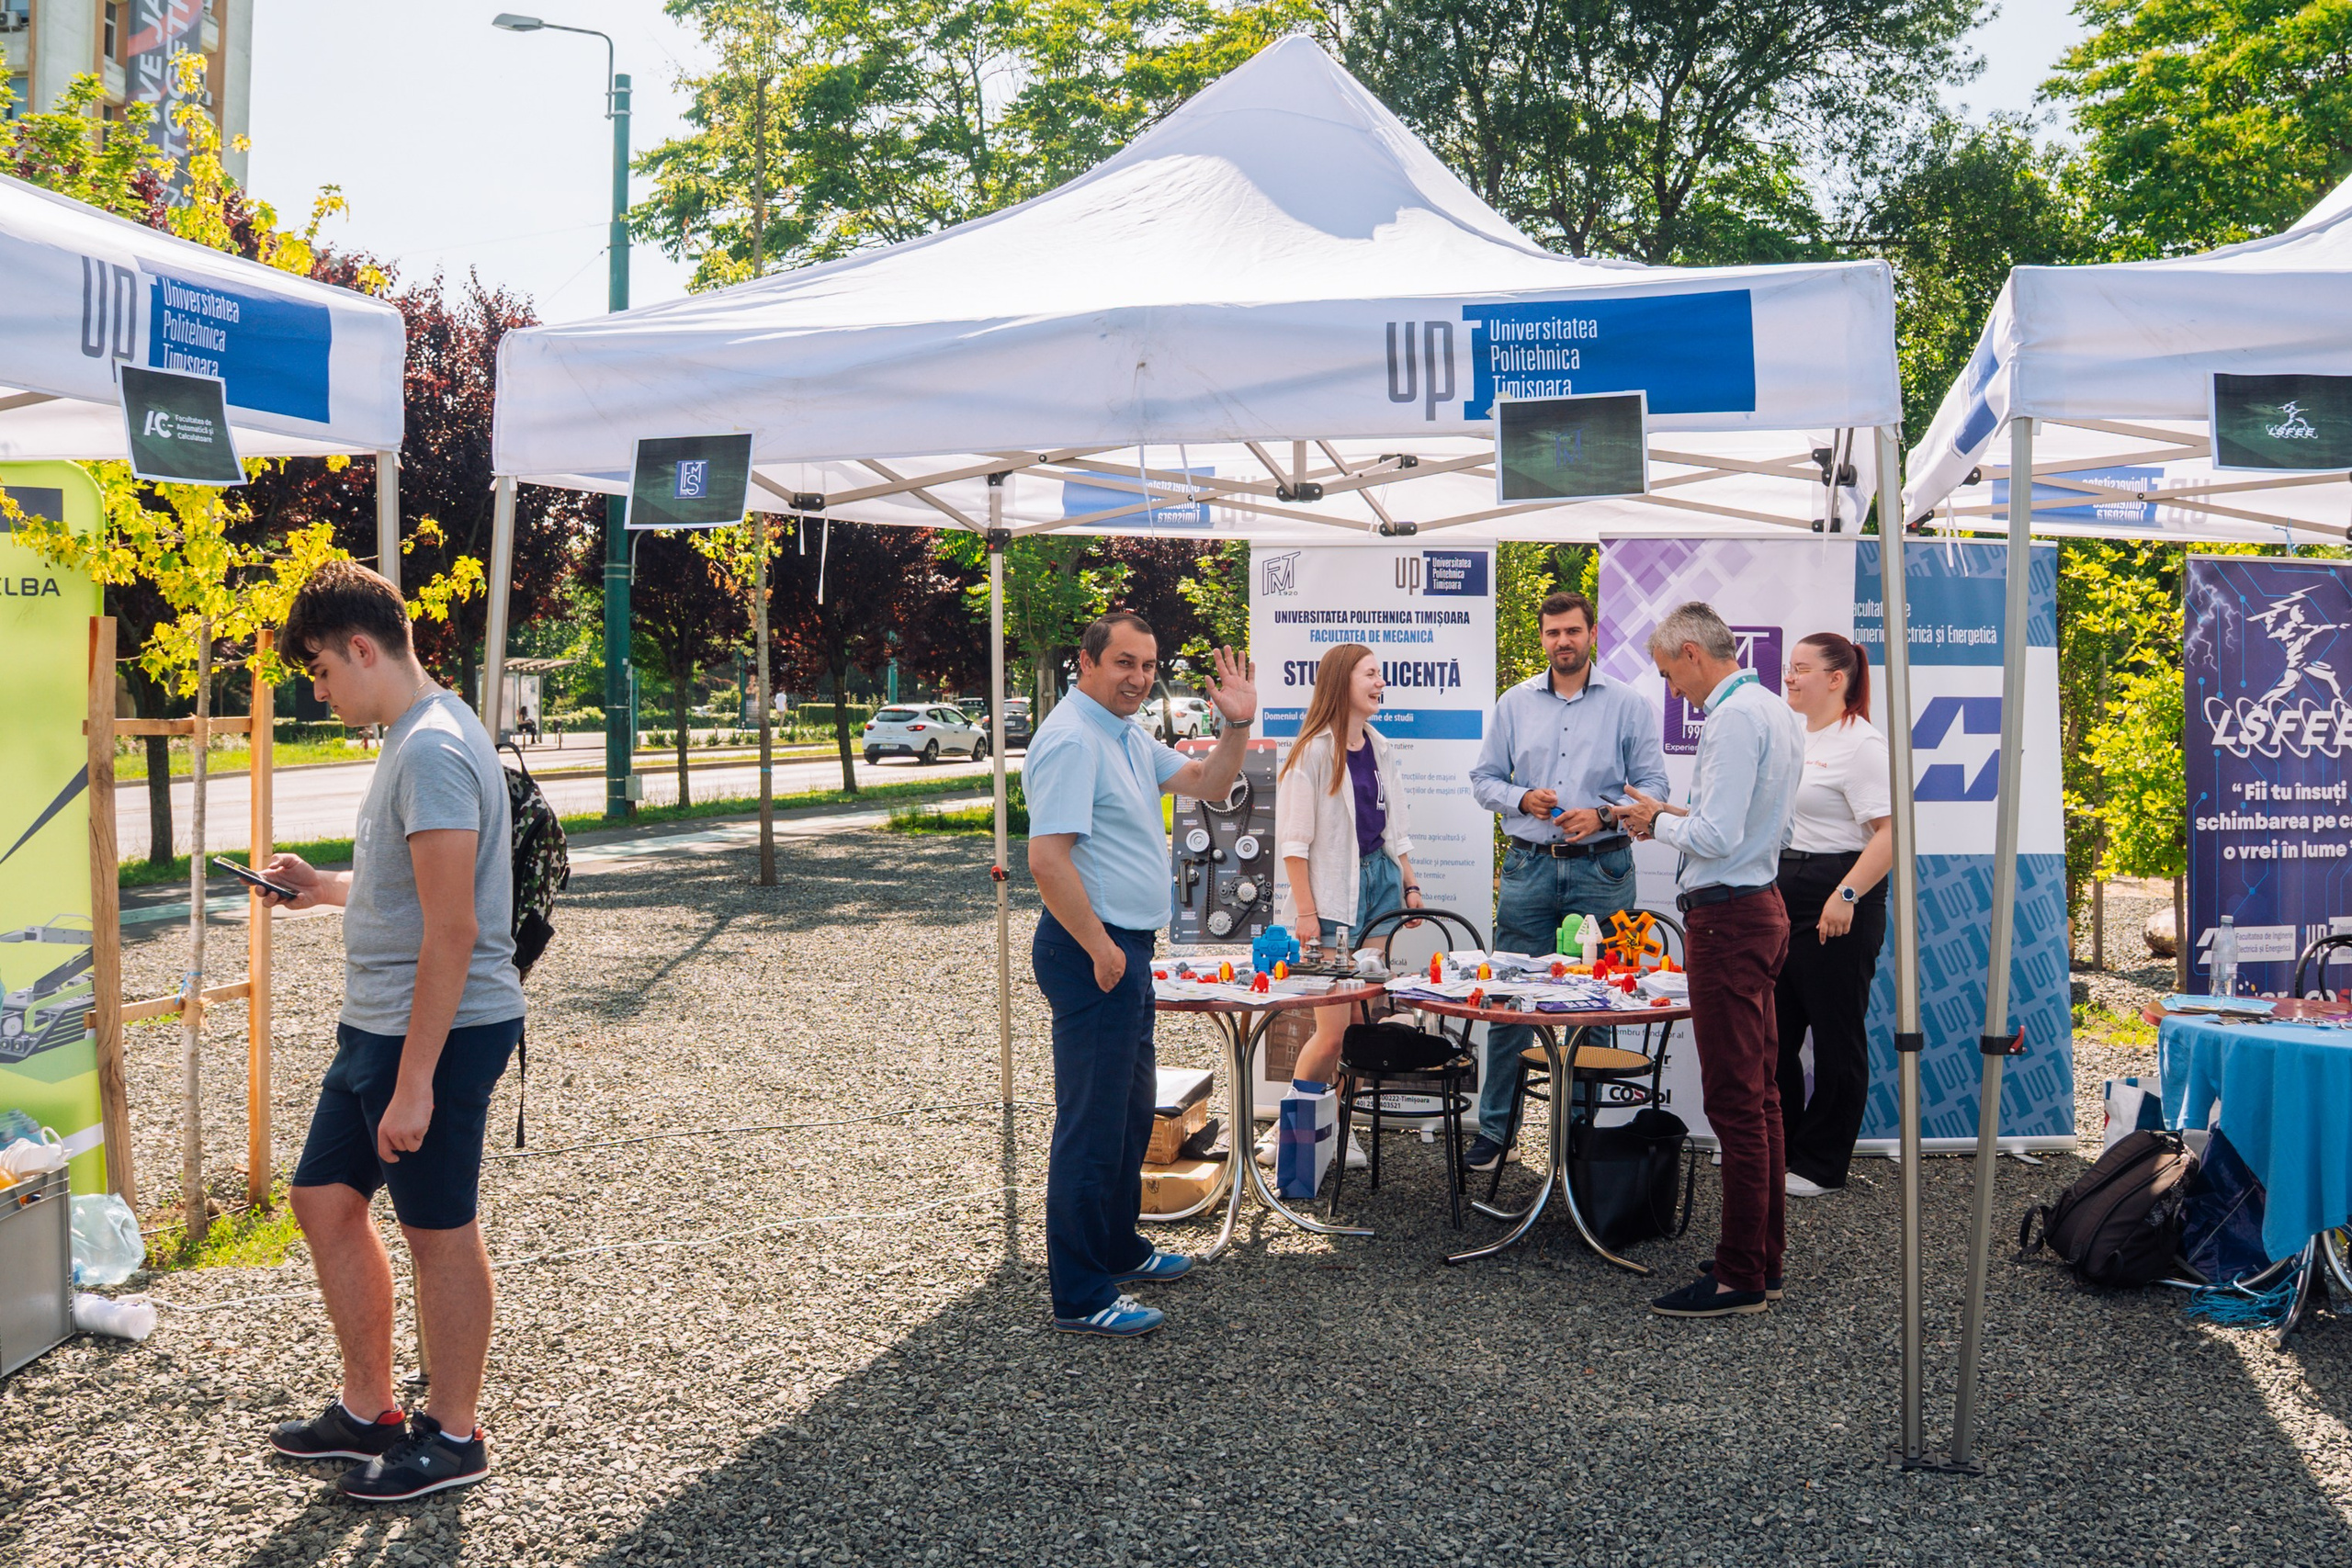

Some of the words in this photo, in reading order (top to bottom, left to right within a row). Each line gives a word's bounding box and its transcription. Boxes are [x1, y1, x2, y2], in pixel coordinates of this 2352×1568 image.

[162, 277, 240, 323] Universitatea
[163, 310, 226, 353] Politehnica
[1489, 317, 1598, 342] Universitatea
[1491, 344, 1580, 372] Politehnica
[175, 414, 204, 425] Facultatea
[177, 433, 212, 443] Calculatoare
[1432, 557, 1472, 569] Universitatea
[1432, 568, 1464, 579] Politehnica
[1274, 611, 1348, 624] UNIVERSITATEA
[1351, 611, 1412, 624] POLITEHNICA
[1415, 611, 1470, 627] TIMIȘOARA
[1310, 629, 1366, 642] FACULTATEA
[1369, 629, 1381, 642] DE
[1383, 628, 1433, 643] MECANICĂ
[1936, 625, 1944, 649] și
[1948, 625, 1996, 646] Energetică
[1264, 711, 1297, 720] Domeniul
[1384, 713, 1393, 722] de
[1394, 713, 1413, 722] studii
[2271, 784, 2291, 800] tu
[2196, 810, 2310, 830] schimbarea
[2313, 815, 2335, 832] pe
[2223, 846, 2235, 860] o
[2238, 840, 2278, 859] vrei
[2281, 840, 2298, 858] în
[2301, 840, 2347, 858] lume
[1440, 859, 1476, 867] pneumatice
[2236, 932, 2263, 941] Facultatea
